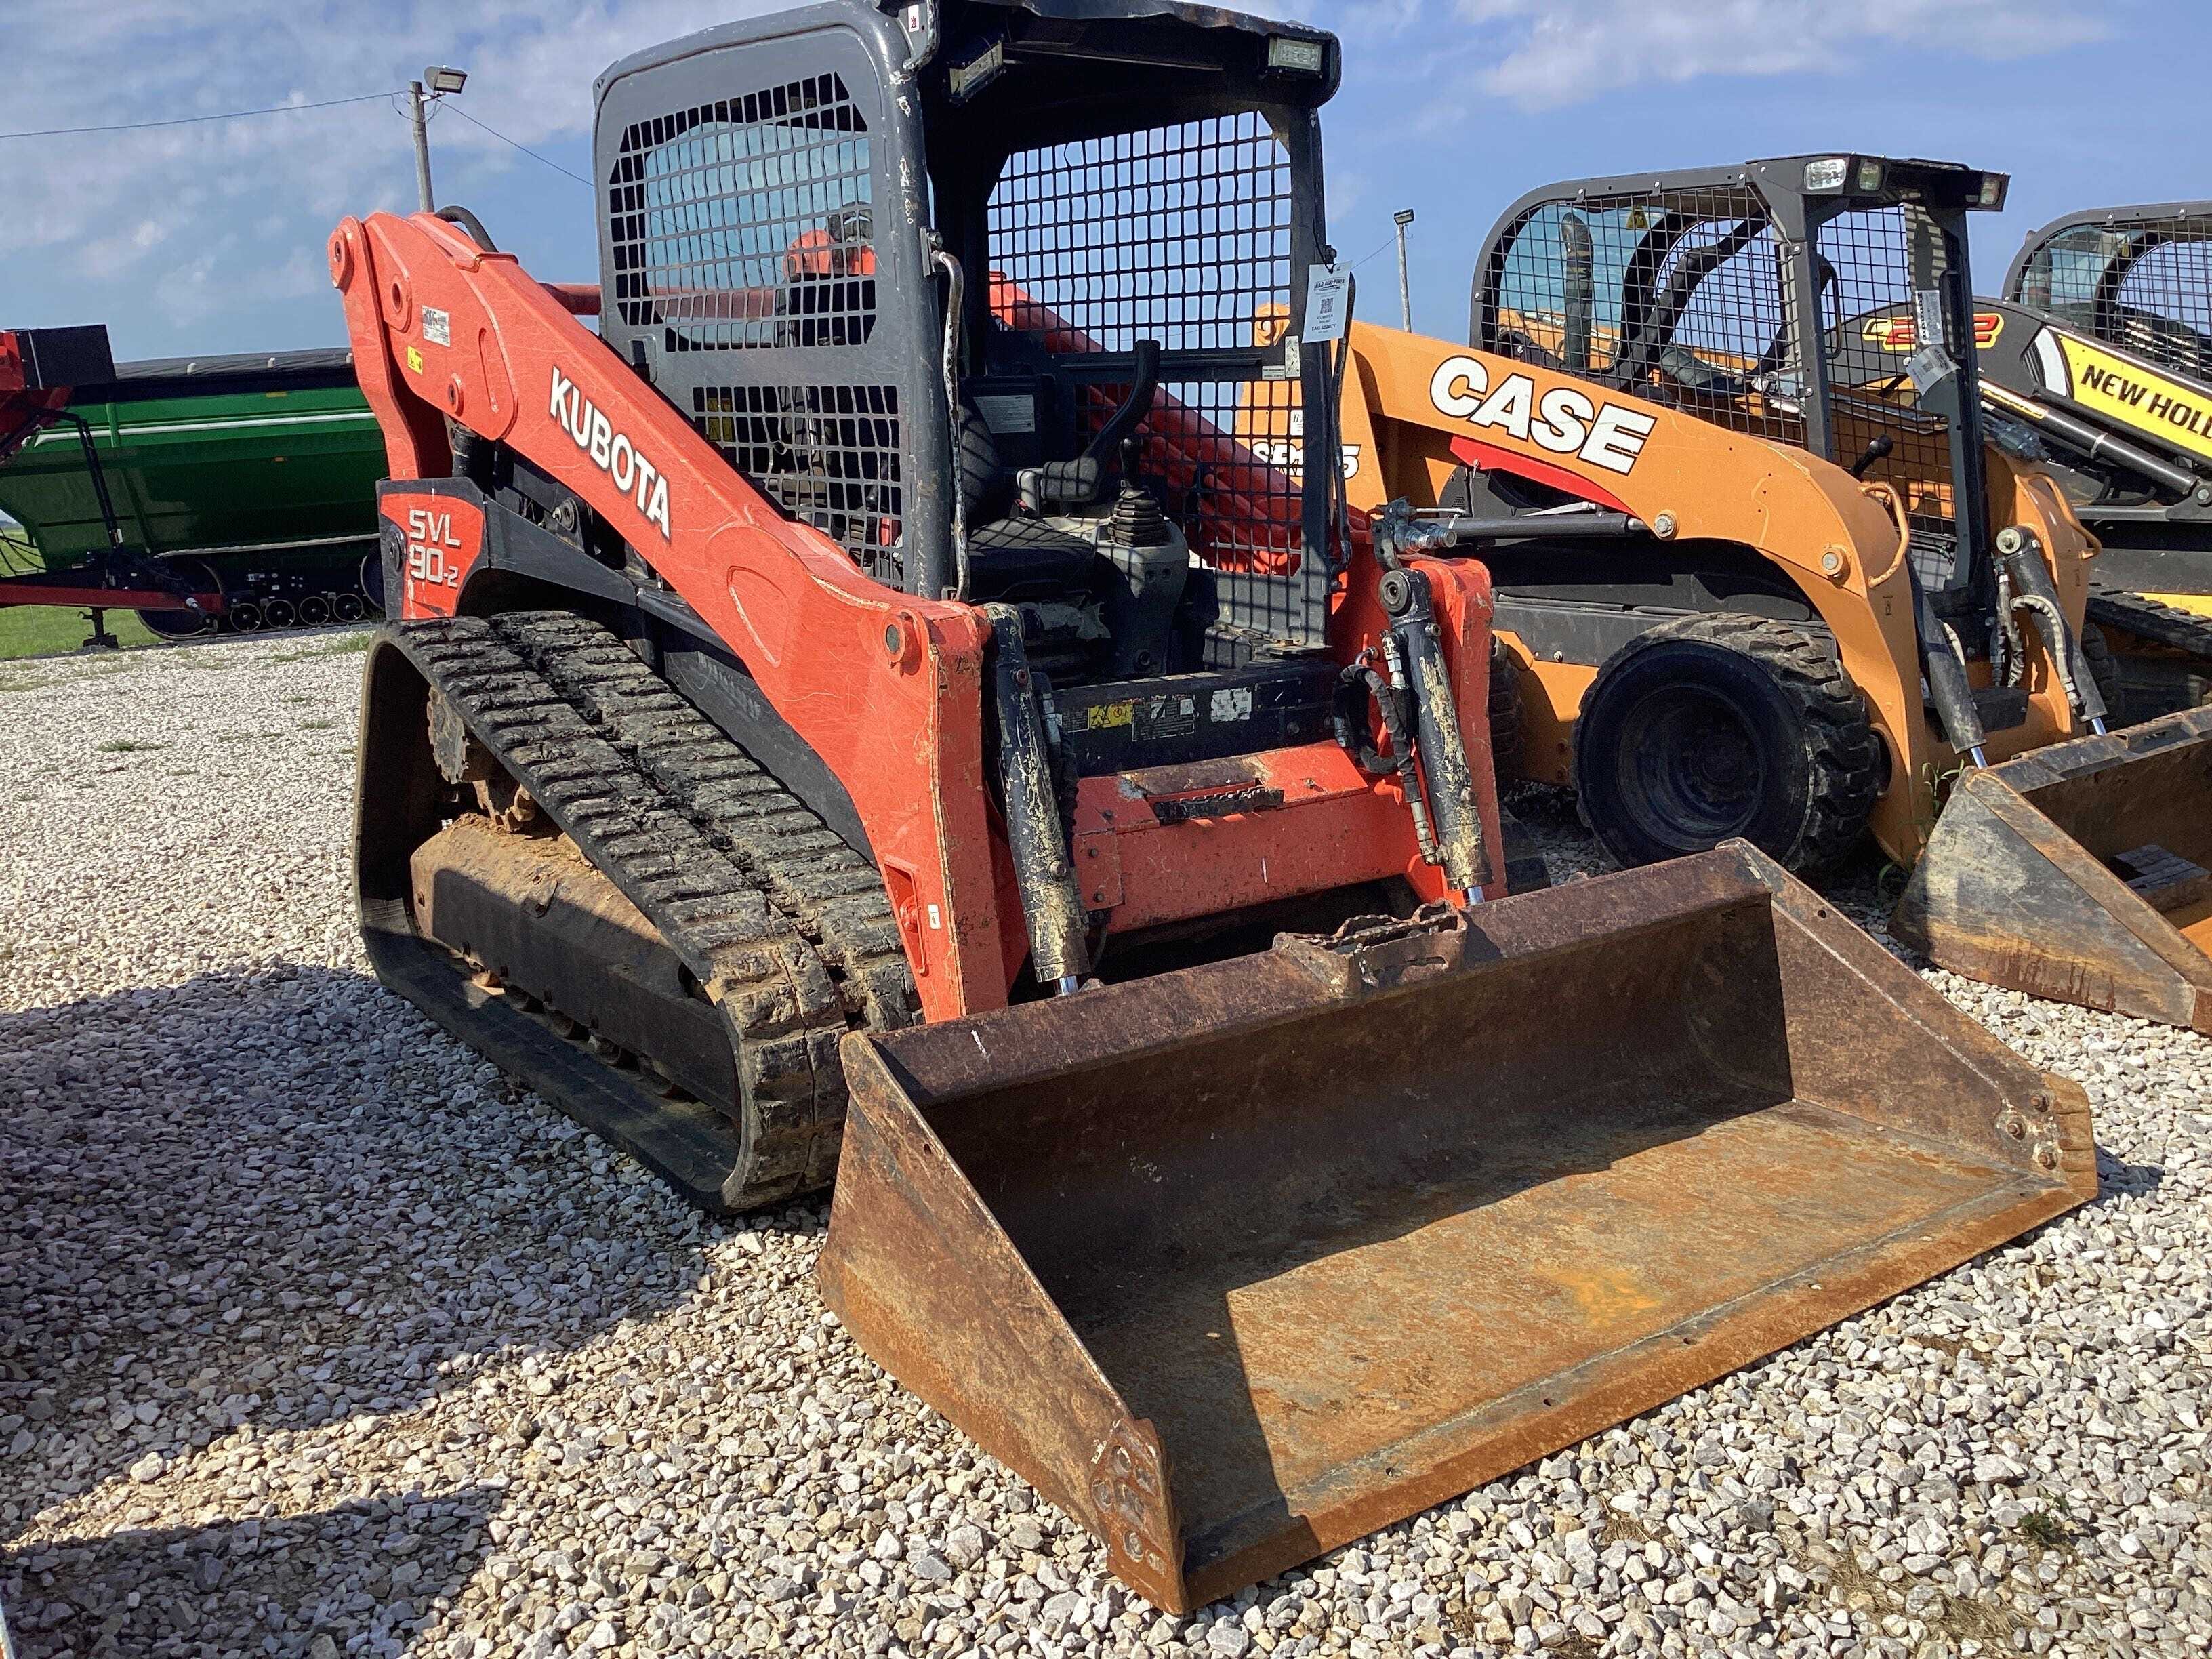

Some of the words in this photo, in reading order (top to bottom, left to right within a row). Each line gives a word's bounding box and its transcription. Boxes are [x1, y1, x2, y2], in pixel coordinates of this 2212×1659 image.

[2081, 364, 2148, 407] NEW
[1430, 354, 1658, 477] CASE
[550, 364, 670, 541] KUBOTA
[409, 509, 461, 549] SVL
[409, 544, 459, 588] 90-2
